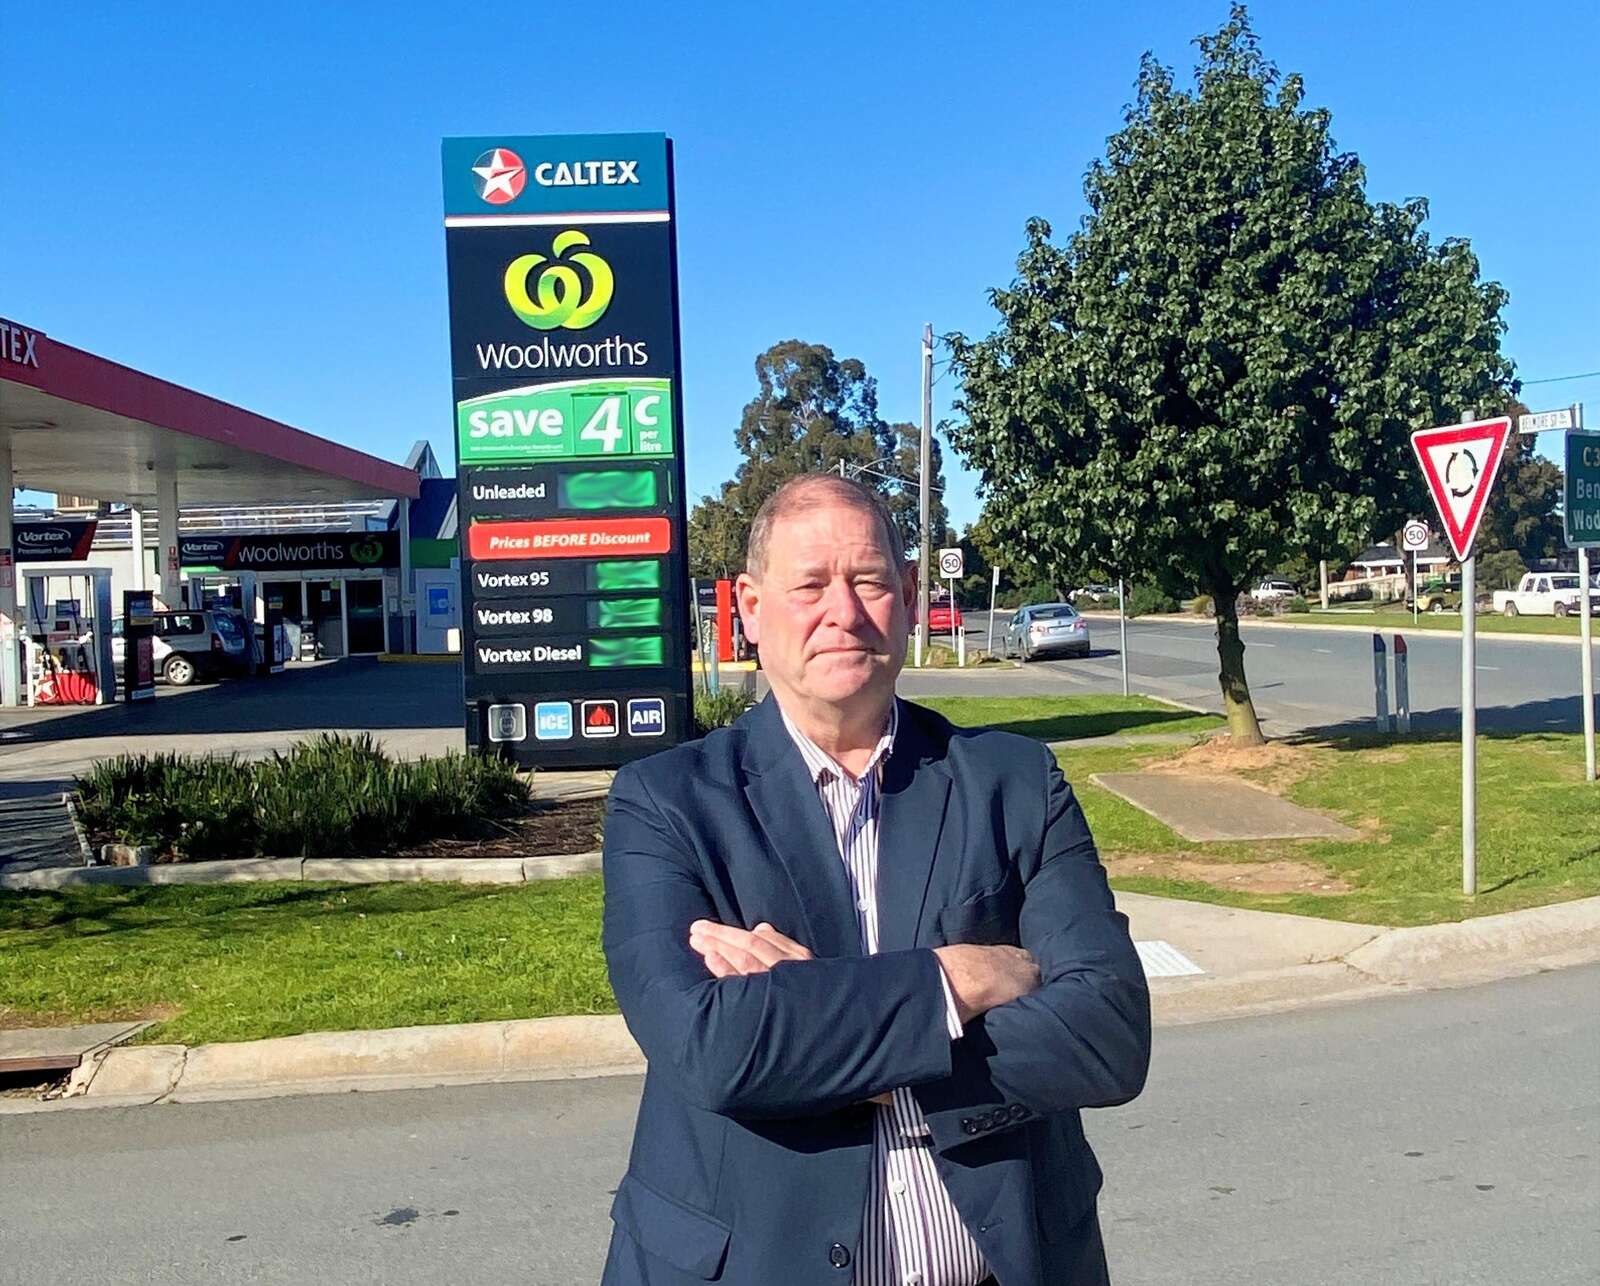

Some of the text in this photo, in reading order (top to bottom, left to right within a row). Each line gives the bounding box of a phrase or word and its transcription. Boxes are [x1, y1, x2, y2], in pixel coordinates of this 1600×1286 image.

[535, 160, 640, 187] CALTEX
[476, 334, 649, 370] Woolworths
[469, 408, 563, 438] save
[581, 397, 622, 452] 4
[639, 431, 658, 443] per
[472, 483, 546, 500] Unleaded
[23, 531, 65, 542] Vortex
[489, 531, 651, 550] Prices BEFORE Discount
[1409, 530, 1423, 540] 50
[239, 541, 344, 563] Woolworths
[945, 559, 958, 569] 50
[478, 571, 550, 588] Vortex 95
[478, 608, 553, 625] Vortex 98
[478, 645, 582, 664] Vortex Diesel
[540, 714, 569, 731] ICE
[631, 710, 661, 726] AIR
